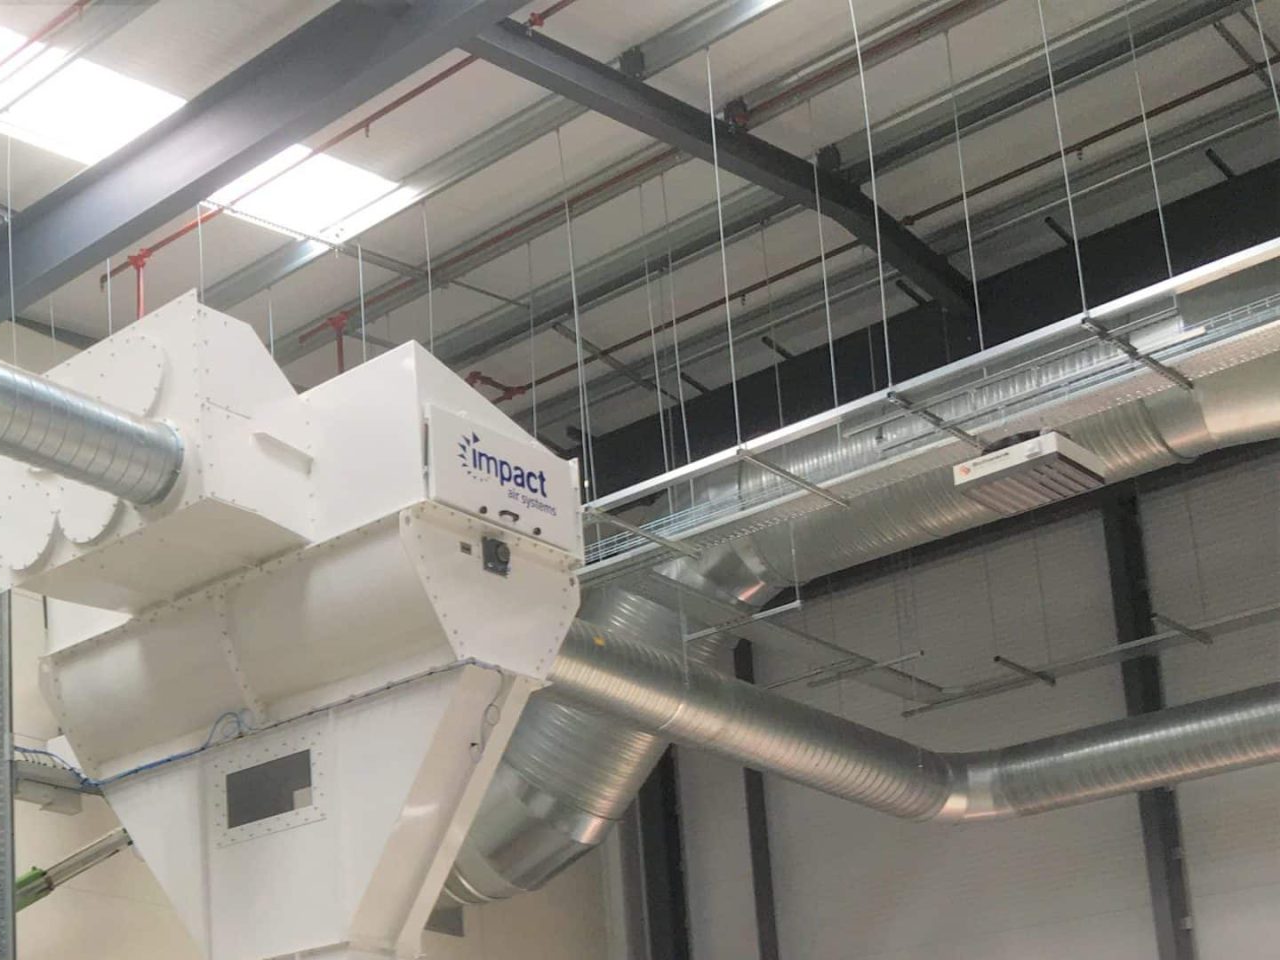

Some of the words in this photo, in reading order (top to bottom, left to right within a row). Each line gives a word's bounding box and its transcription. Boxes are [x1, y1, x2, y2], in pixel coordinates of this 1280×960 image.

[471, 436, 547, 498] impact
[507, 488, 520, 500] air
[521, 494, 557, 517] systems
